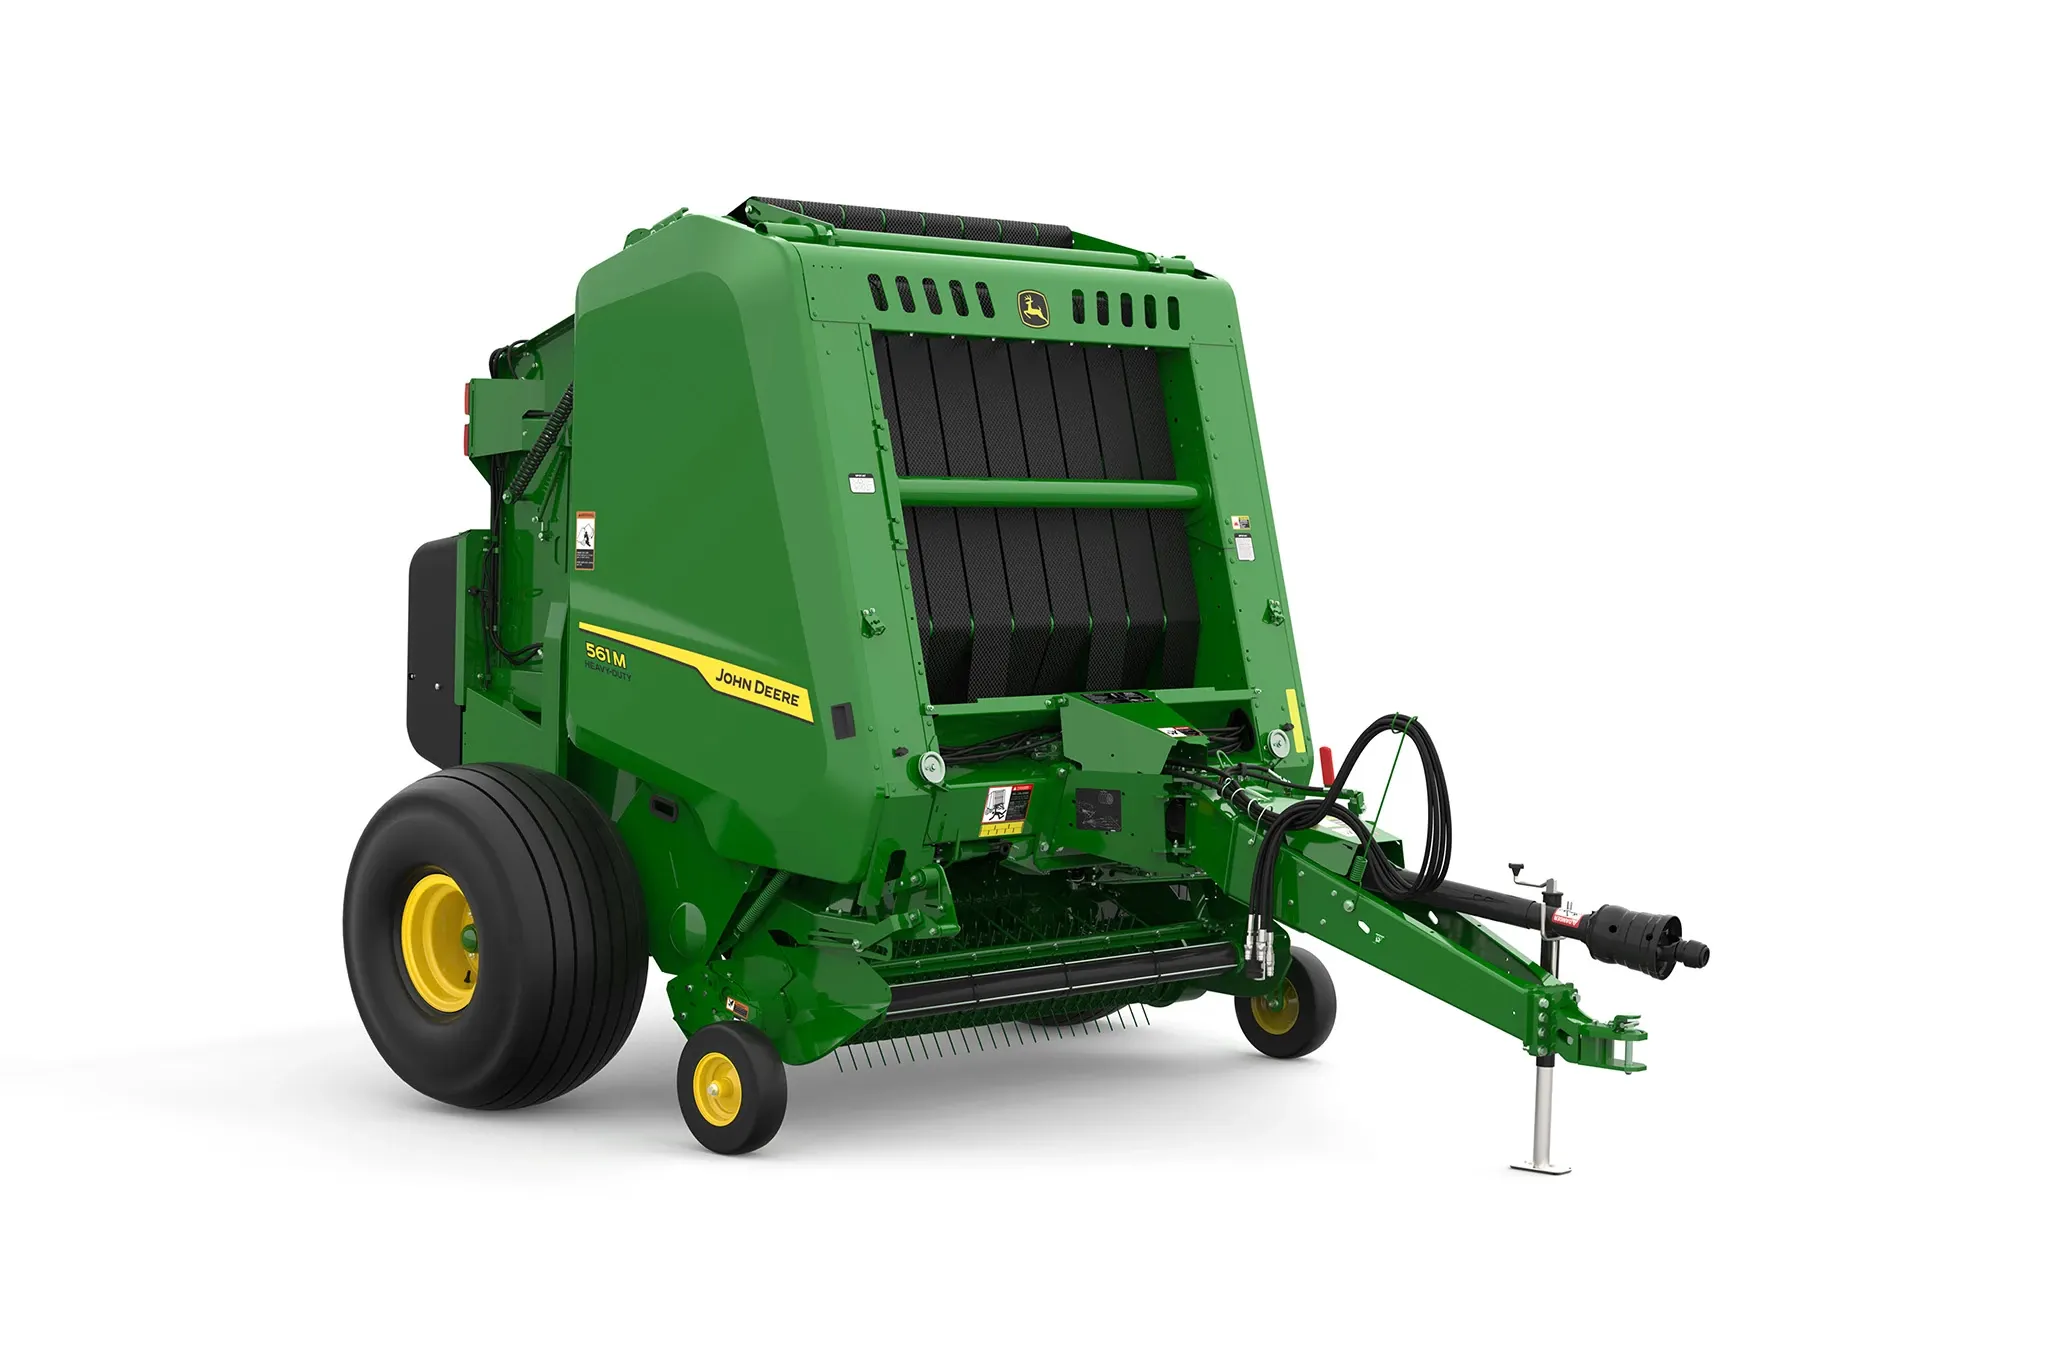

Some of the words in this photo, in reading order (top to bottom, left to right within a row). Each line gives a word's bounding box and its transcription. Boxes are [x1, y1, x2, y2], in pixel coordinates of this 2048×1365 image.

[585, 641, 611, 664] 561
[612, 650, 627, 669] M
[584, 660, 632, 682] HEAVY-DUTY
[715, 668, 752, 692] JOHN
[754, 679, 800, 707] DEERE
